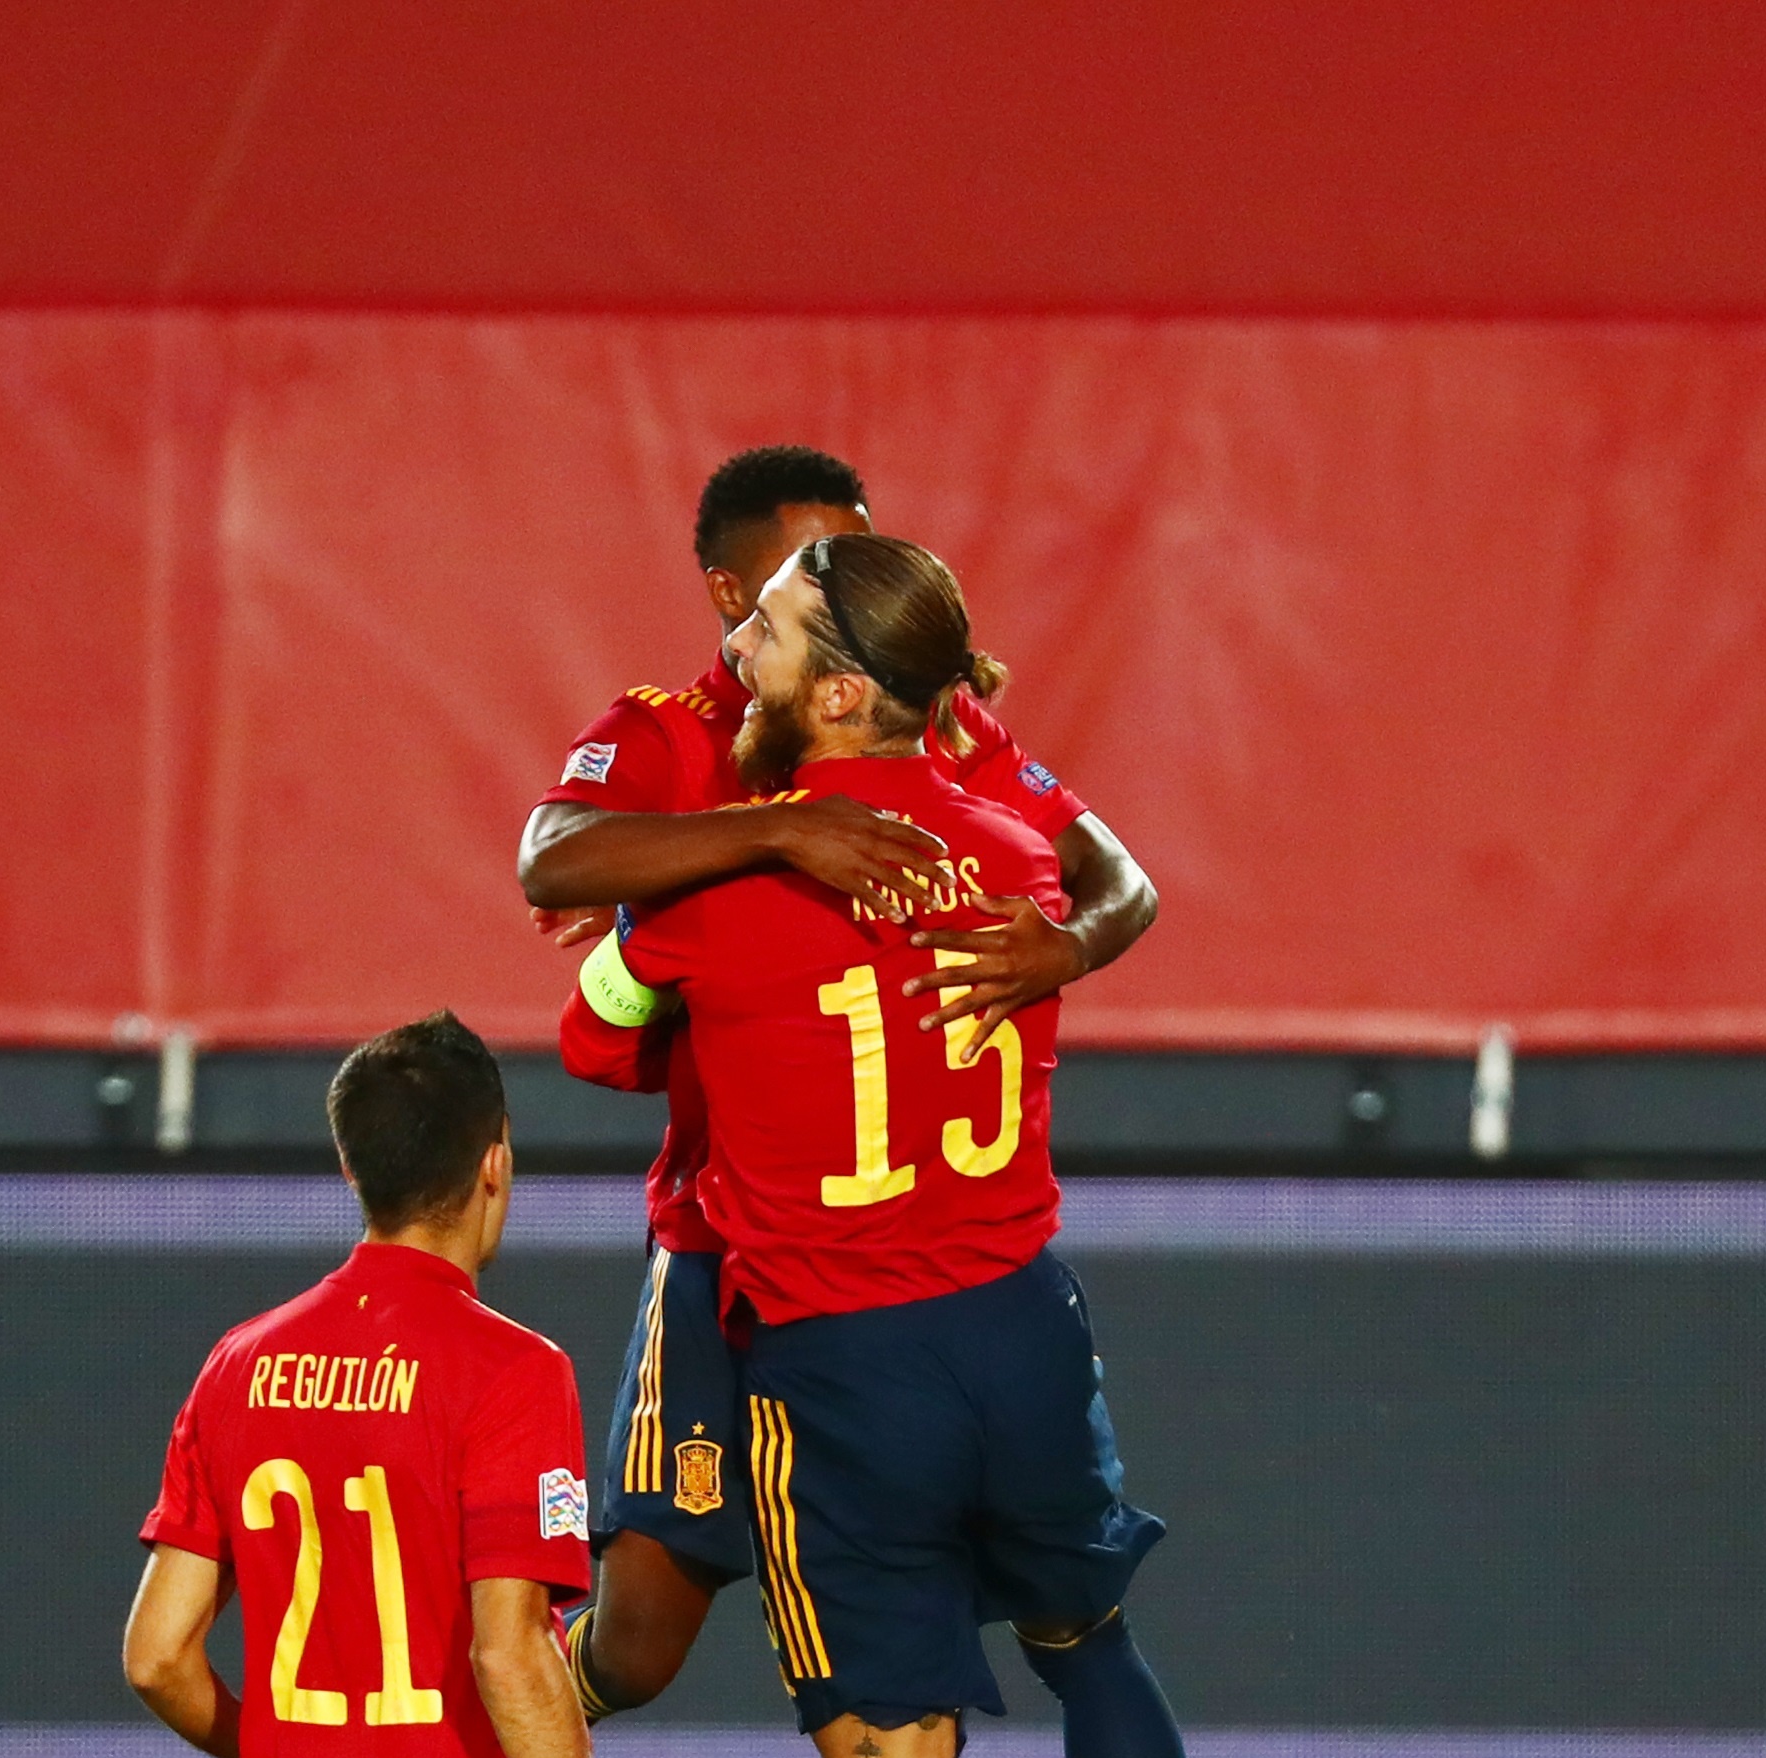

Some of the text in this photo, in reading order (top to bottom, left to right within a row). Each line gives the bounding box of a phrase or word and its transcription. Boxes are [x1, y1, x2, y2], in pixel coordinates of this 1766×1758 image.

[818, 914, 1023, 1207] 15
[247, 1343, 419, 1414] REGUILÓN
[241, 1458, 443, 1726] 21
